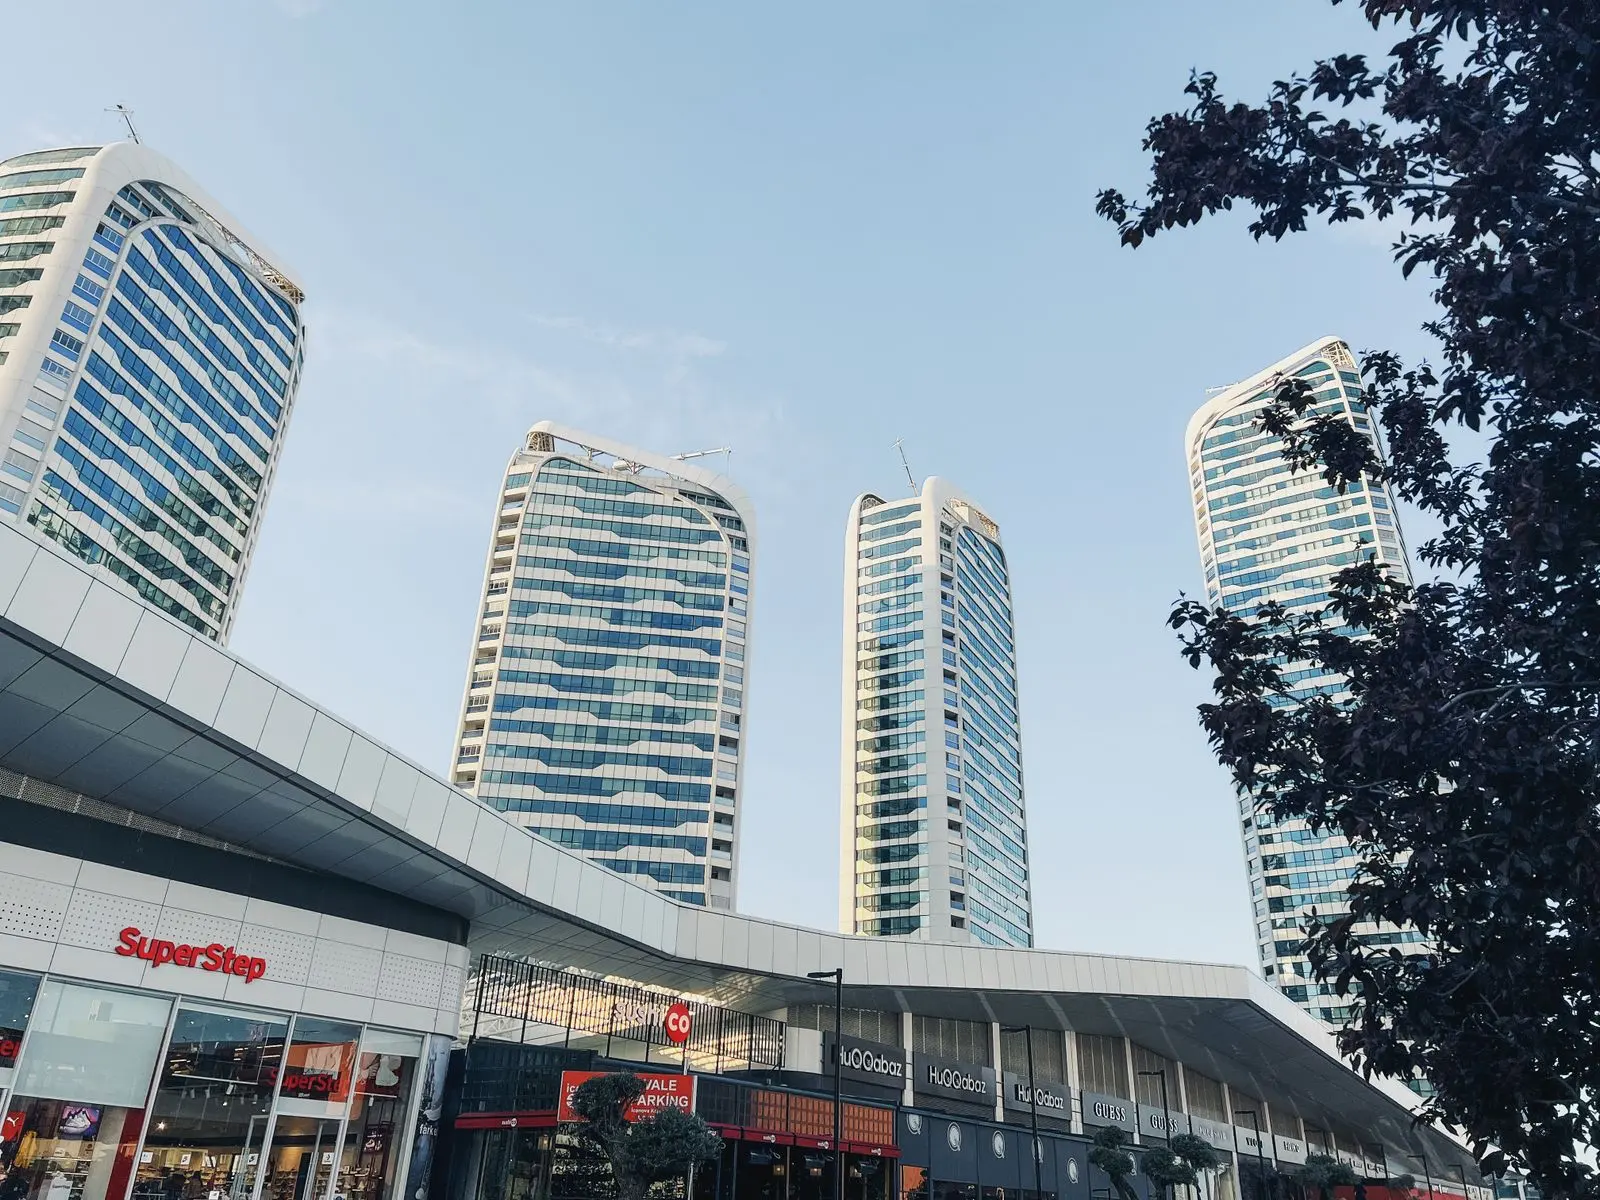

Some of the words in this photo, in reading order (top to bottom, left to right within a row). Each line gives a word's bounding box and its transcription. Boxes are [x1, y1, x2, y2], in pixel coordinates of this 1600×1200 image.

[115, 926, 267, 984] SuperStep
[929, 1065, 987, 1094] HuQQabaz
[1095, 1102, 1127, 1123] GUESS
[1151, 1114, 1180, 1134] GUSS
